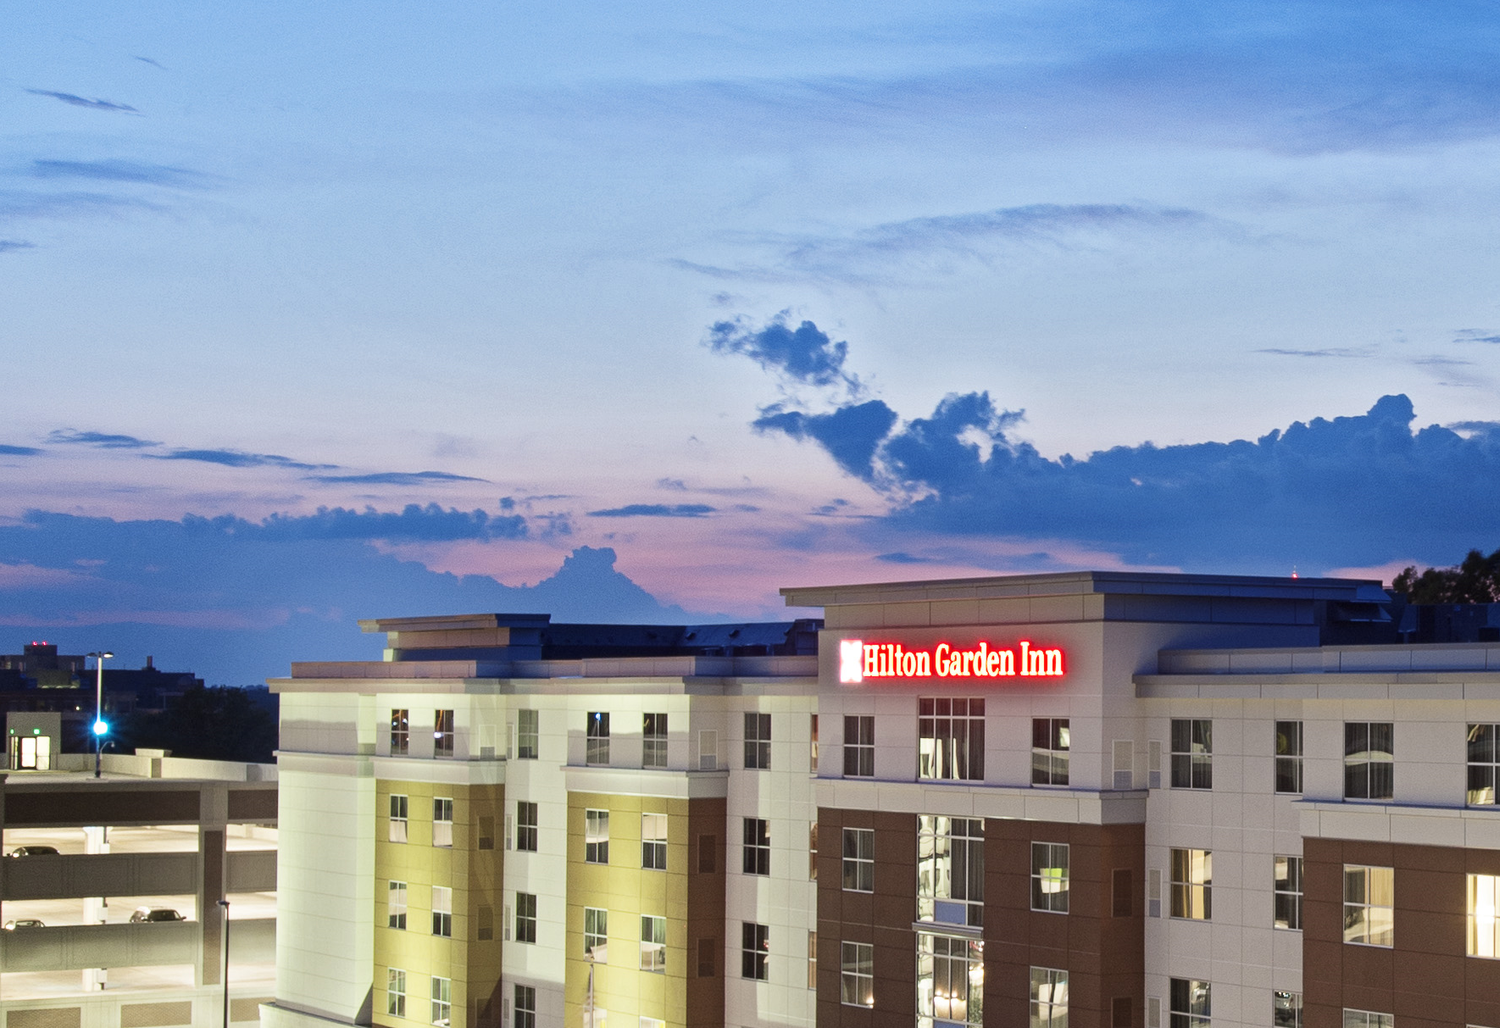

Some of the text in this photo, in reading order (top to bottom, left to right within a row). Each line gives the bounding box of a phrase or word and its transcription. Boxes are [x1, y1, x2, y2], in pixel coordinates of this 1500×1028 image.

[863, 641, 1063, 677] Hilton Garden Inn
